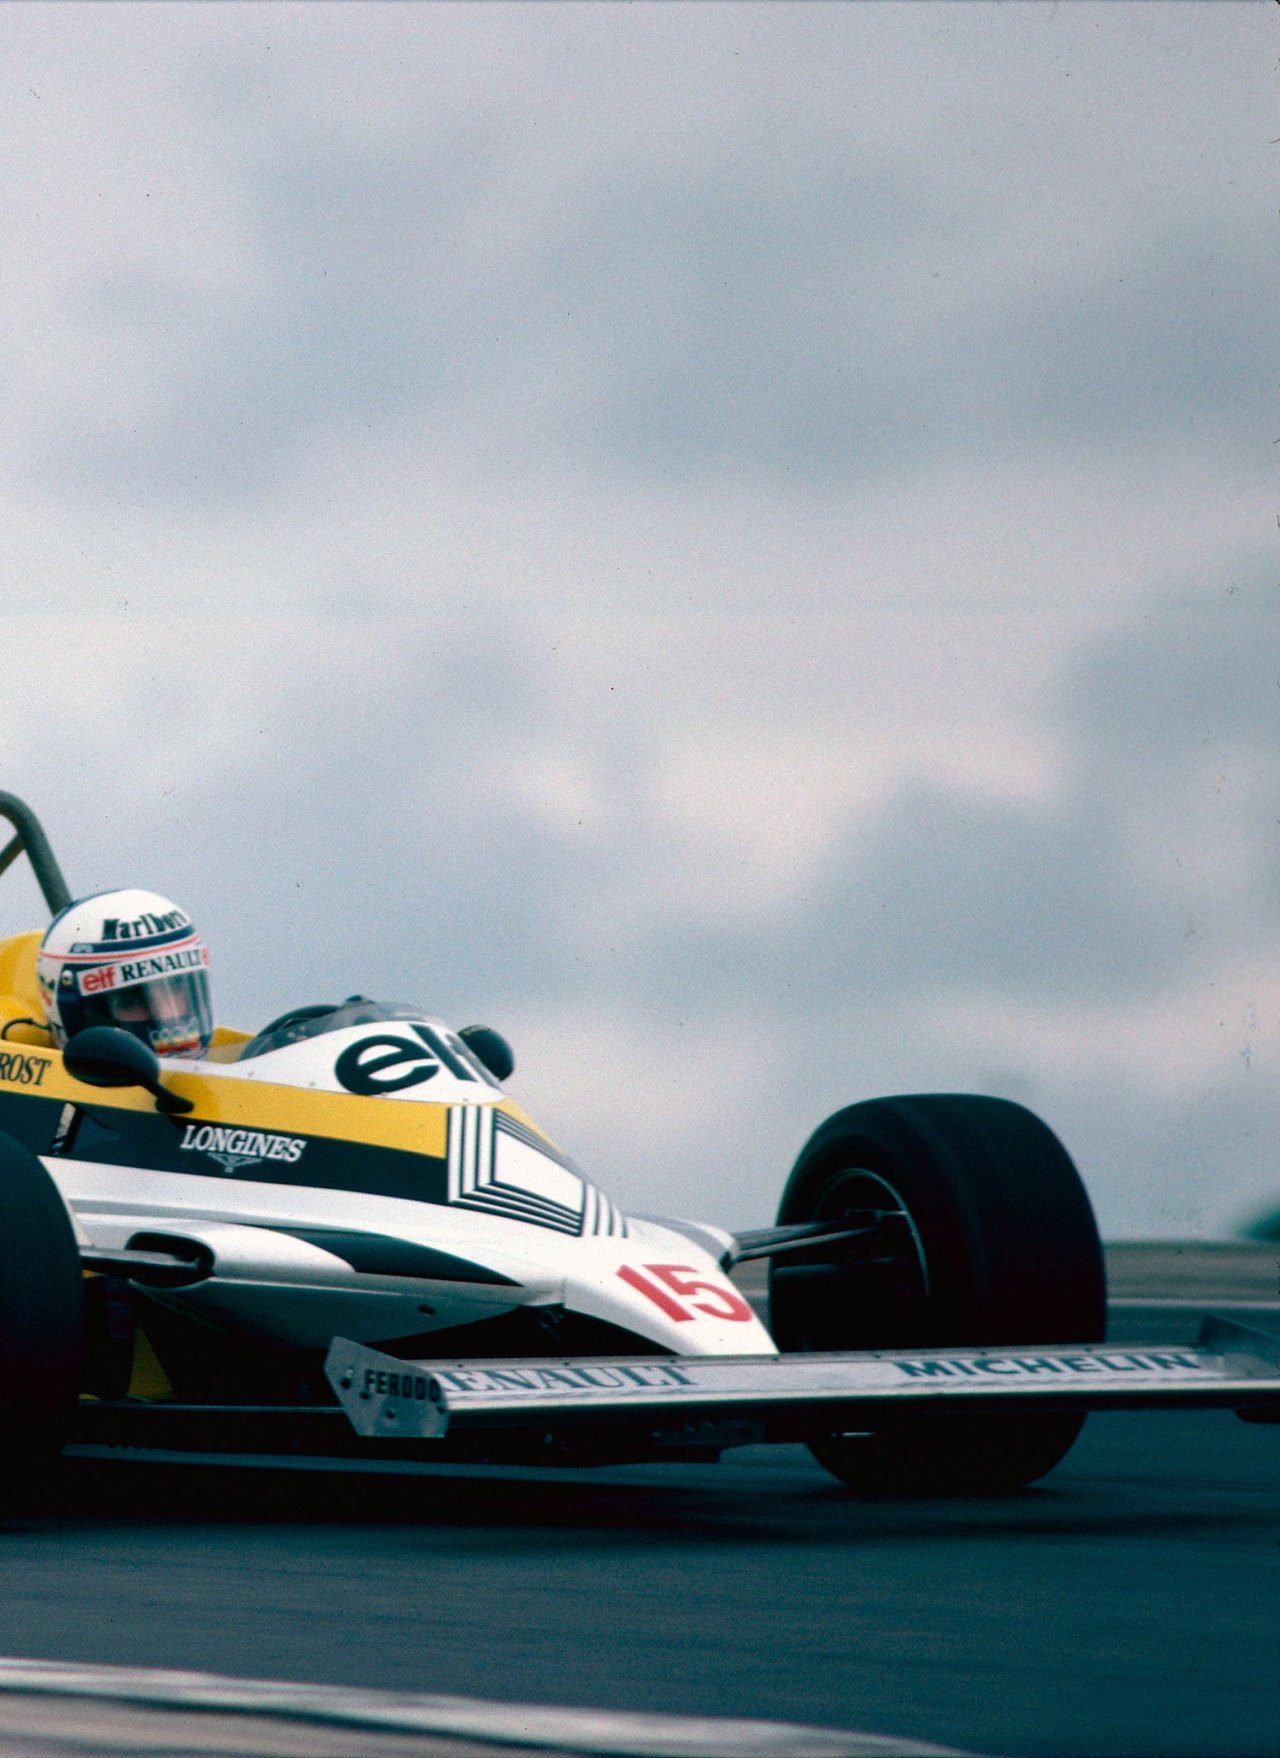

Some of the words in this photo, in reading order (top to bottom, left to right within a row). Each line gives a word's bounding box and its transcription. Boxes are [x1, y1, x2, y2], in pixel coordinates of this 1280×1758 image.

[82, 966, 116, 991] elf
[180, 1124, 307, 1163] LONGINES
[616, 1264, 754, 1322] 15
[441, 1366, 700, 1393] ENAULT
[893, 1353, 1202, 1377] MICHELIN
[365, 1368, 442, 1402] FERODO
